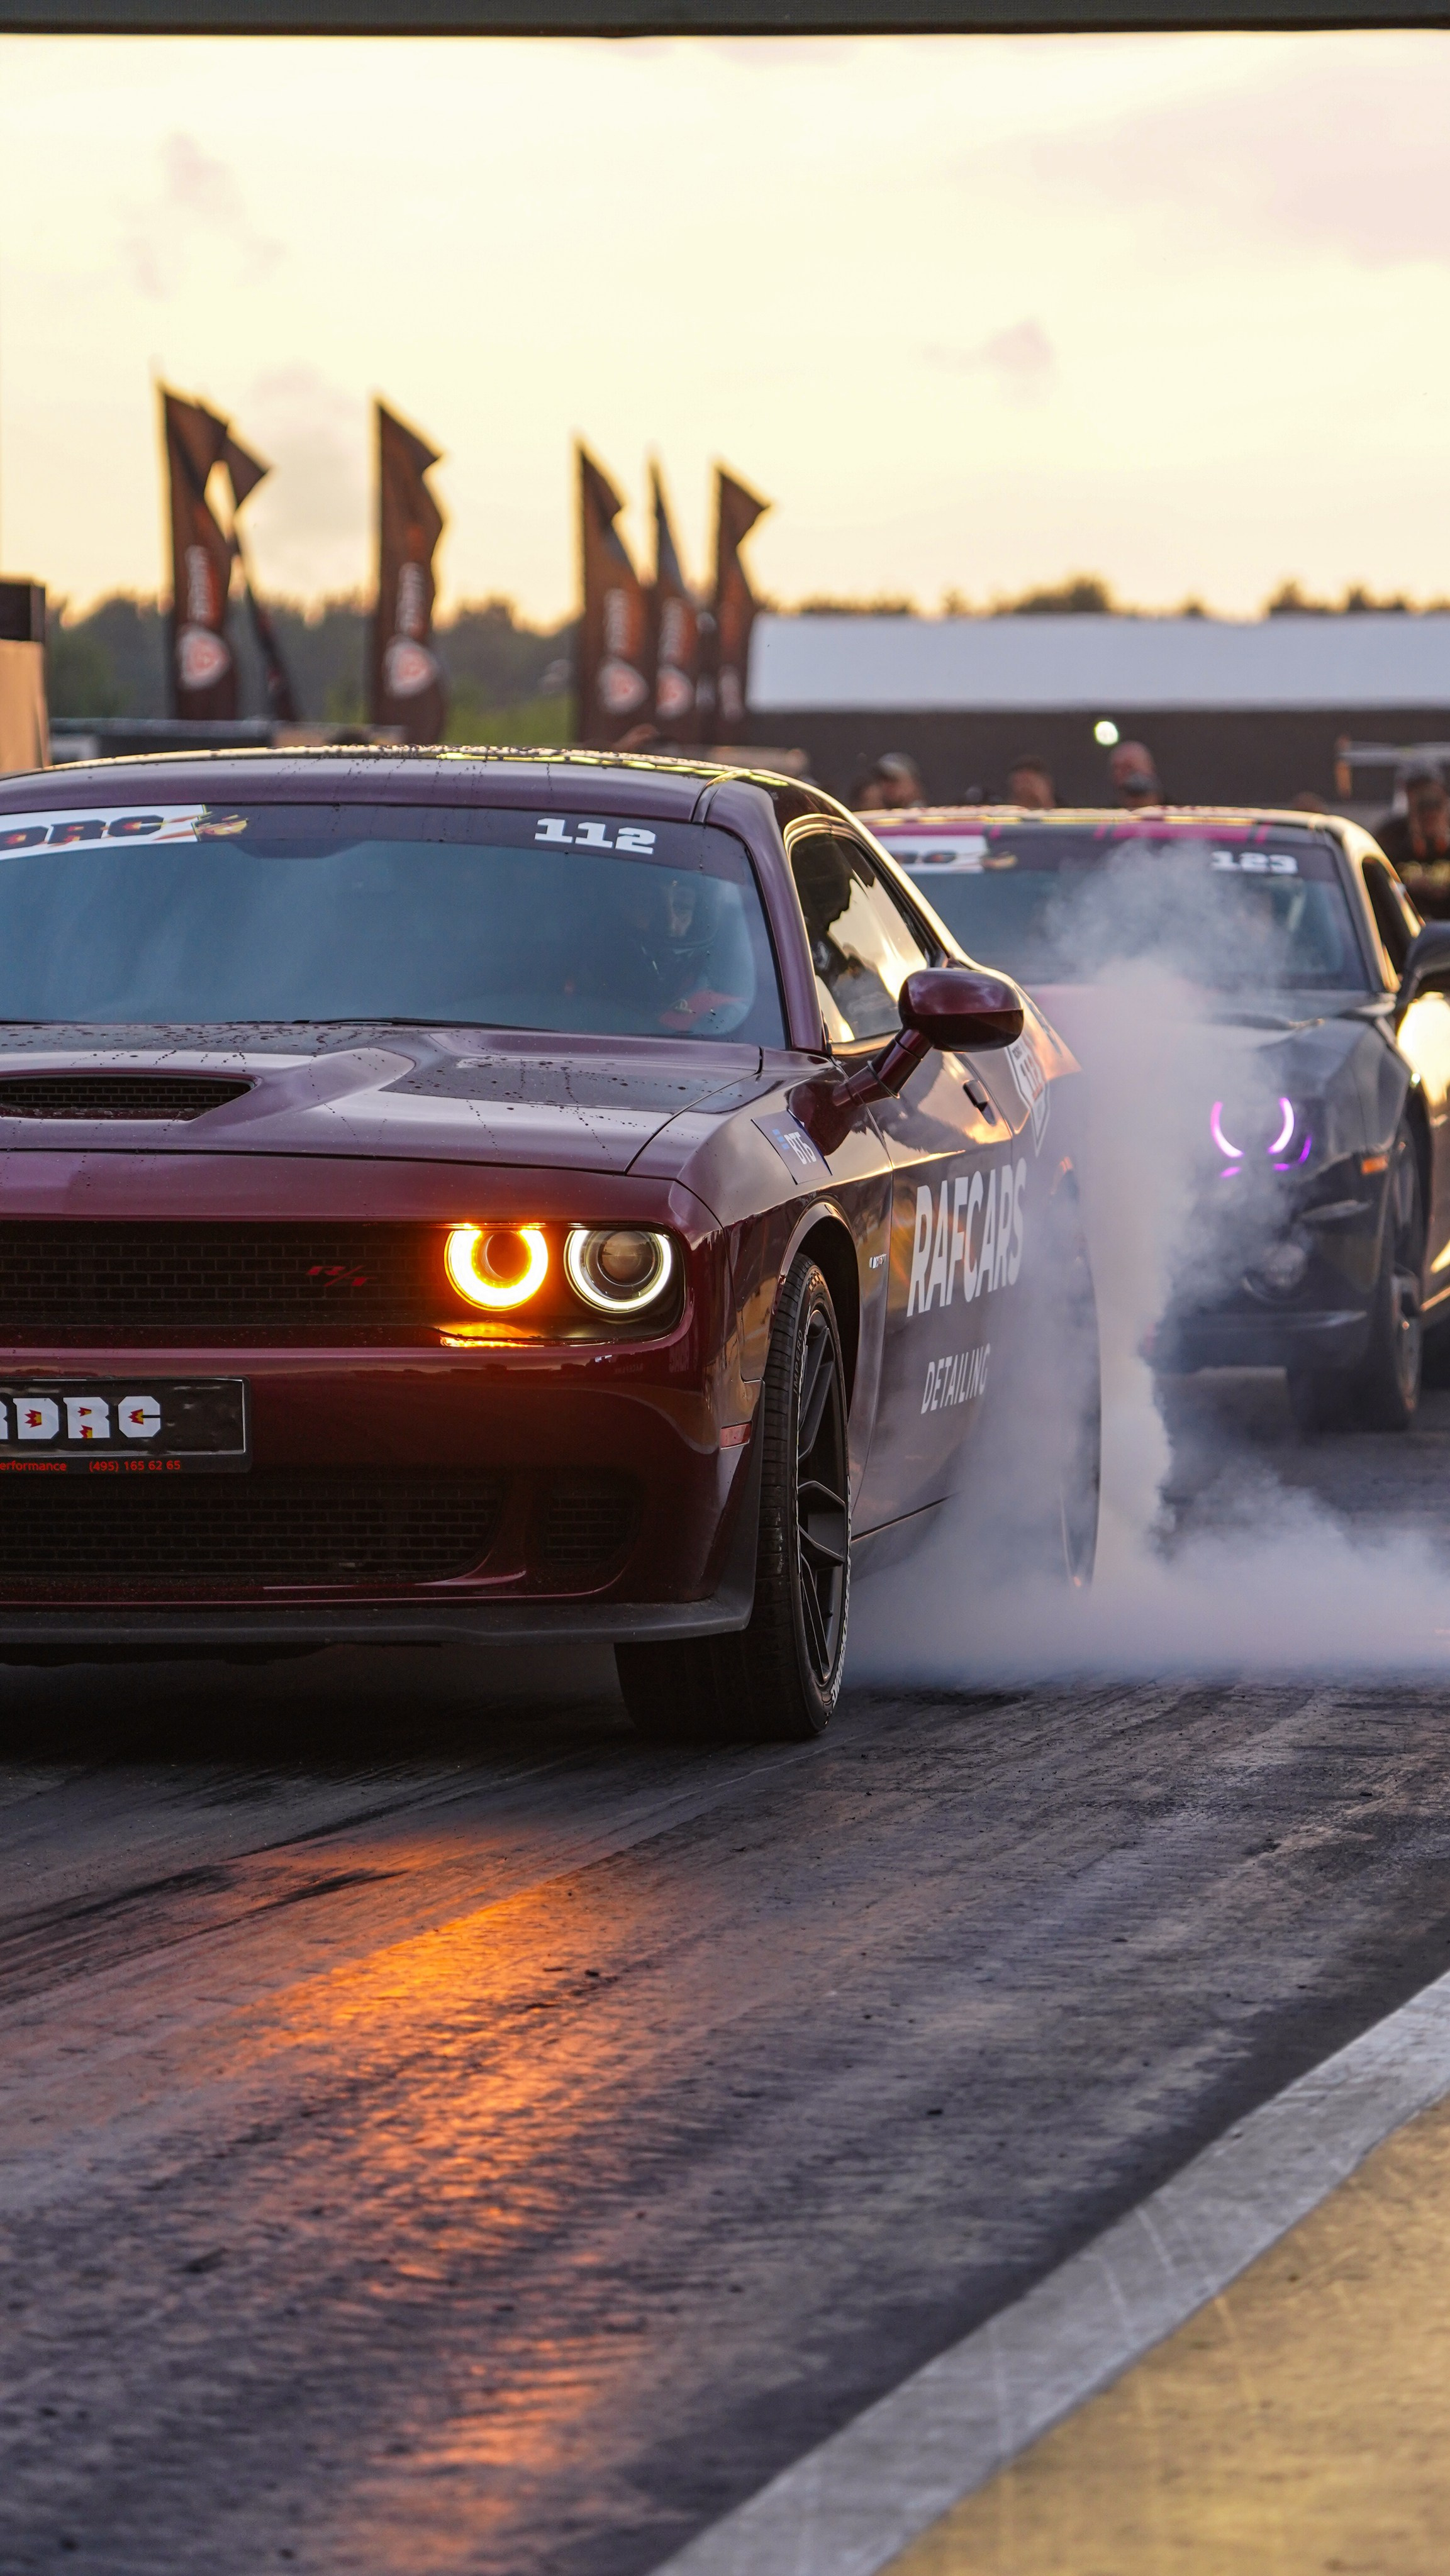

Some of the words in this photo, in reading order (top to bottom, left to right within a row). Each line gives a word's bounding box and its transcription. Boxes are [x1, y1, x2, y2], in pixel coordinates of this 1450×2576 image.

[535, 818, 656, 855] 112
[1210, 851, 1298, 874] 123
[784, 1131, 817, 1164] ВТБ
[906, 1158, 1027, 1318] RAFCARS
[793, 1330, 803, 1395] IMPERO
[920, 1343, 991, 1414] DETAILING
[0, 1396, 162, 1440] DRC
[89, 1460, 119, 1472] (495)
[124, 1460, 145, 1470] 165
[148, 1460, 162, 1470] 62
[166, 1460, 181, 1470] 65
